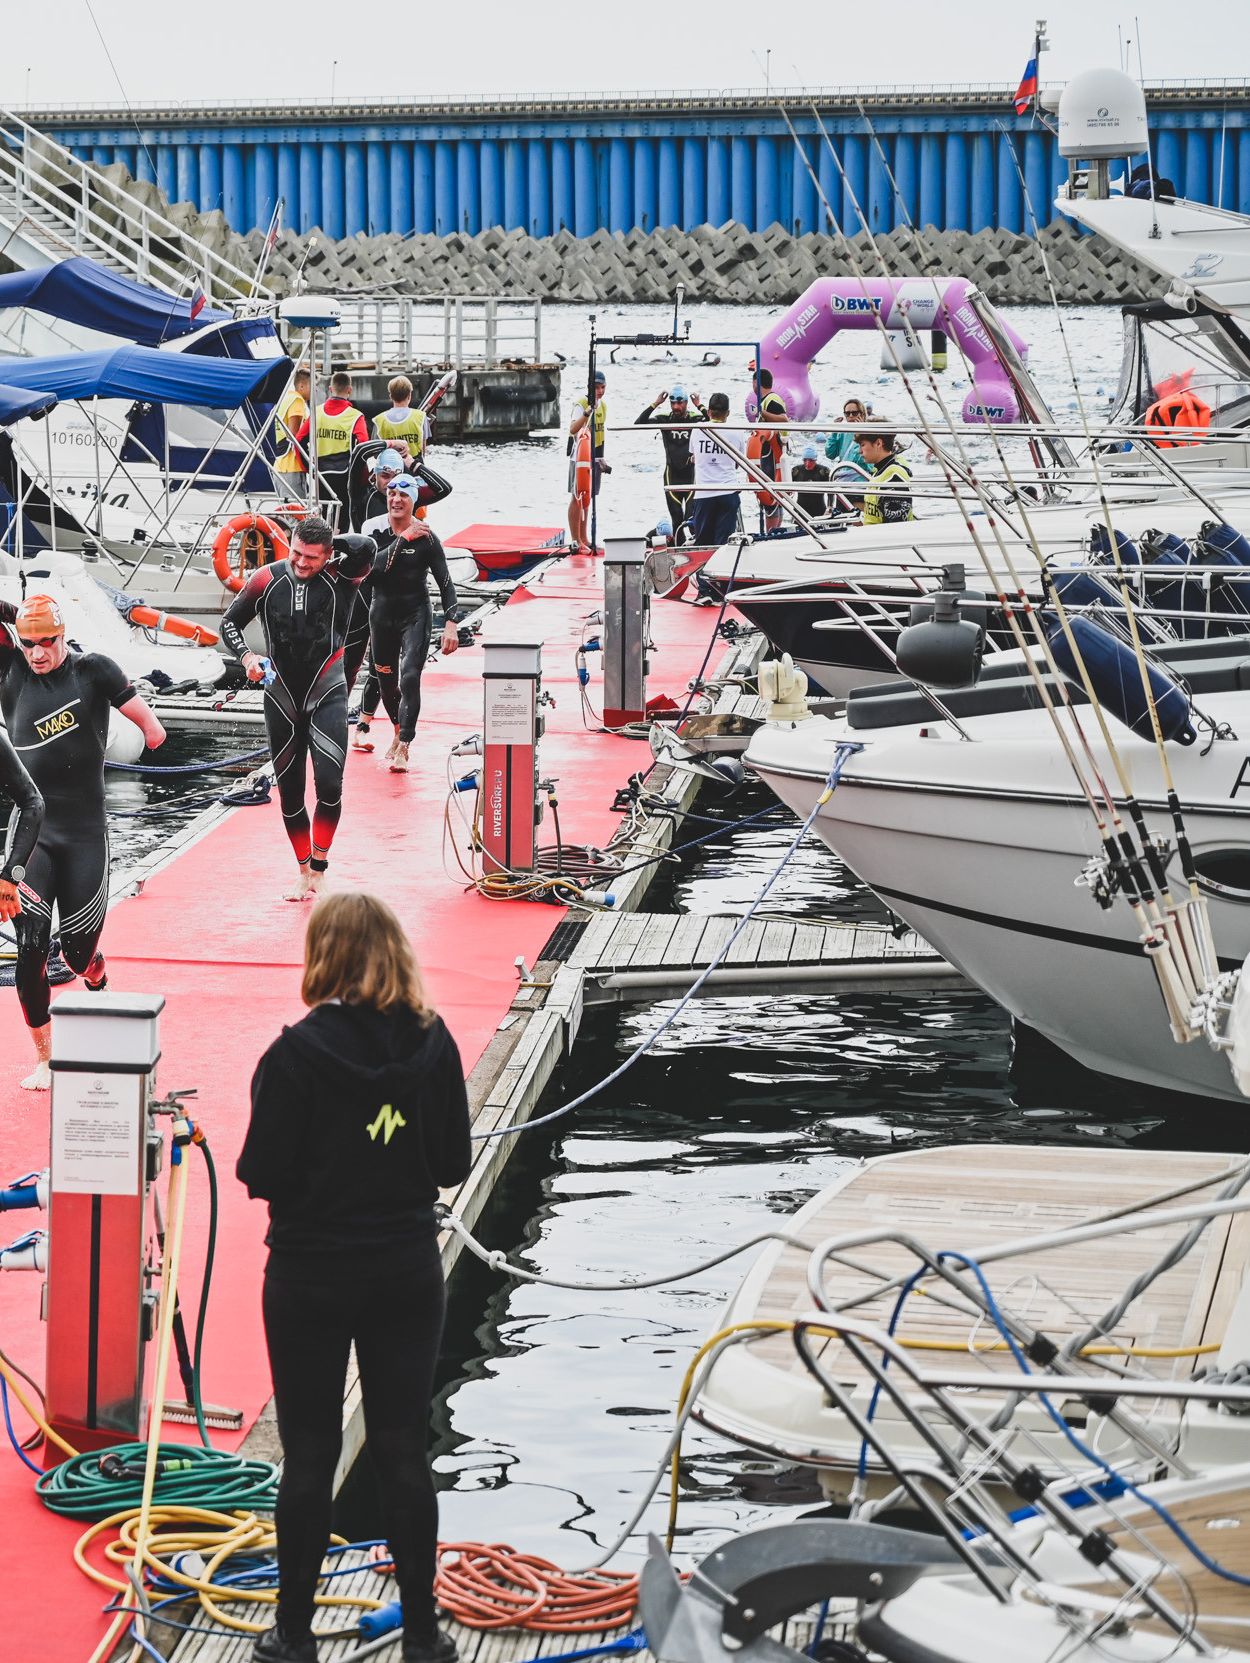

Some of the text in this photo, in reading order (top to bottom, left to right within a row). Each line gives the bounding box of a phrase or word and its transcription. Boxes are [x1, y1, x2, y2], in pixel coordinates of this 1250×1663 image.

[1180, 253, 1224, 279] 52
[847, 298, 882, 311] BWT
[955, 305, 977, 327] IRON
[775, 304, 818, 347] IRON STAR
[976, 405, 1004, 418] BWT
[51, 431, 118, 448] 10160280
[671, 430, 689, 439] TYR
[295, 583, 306, 611] HUUB
[223, 621, 246, 650] AEGIS
[36, 710, 75, 740] MAKO
